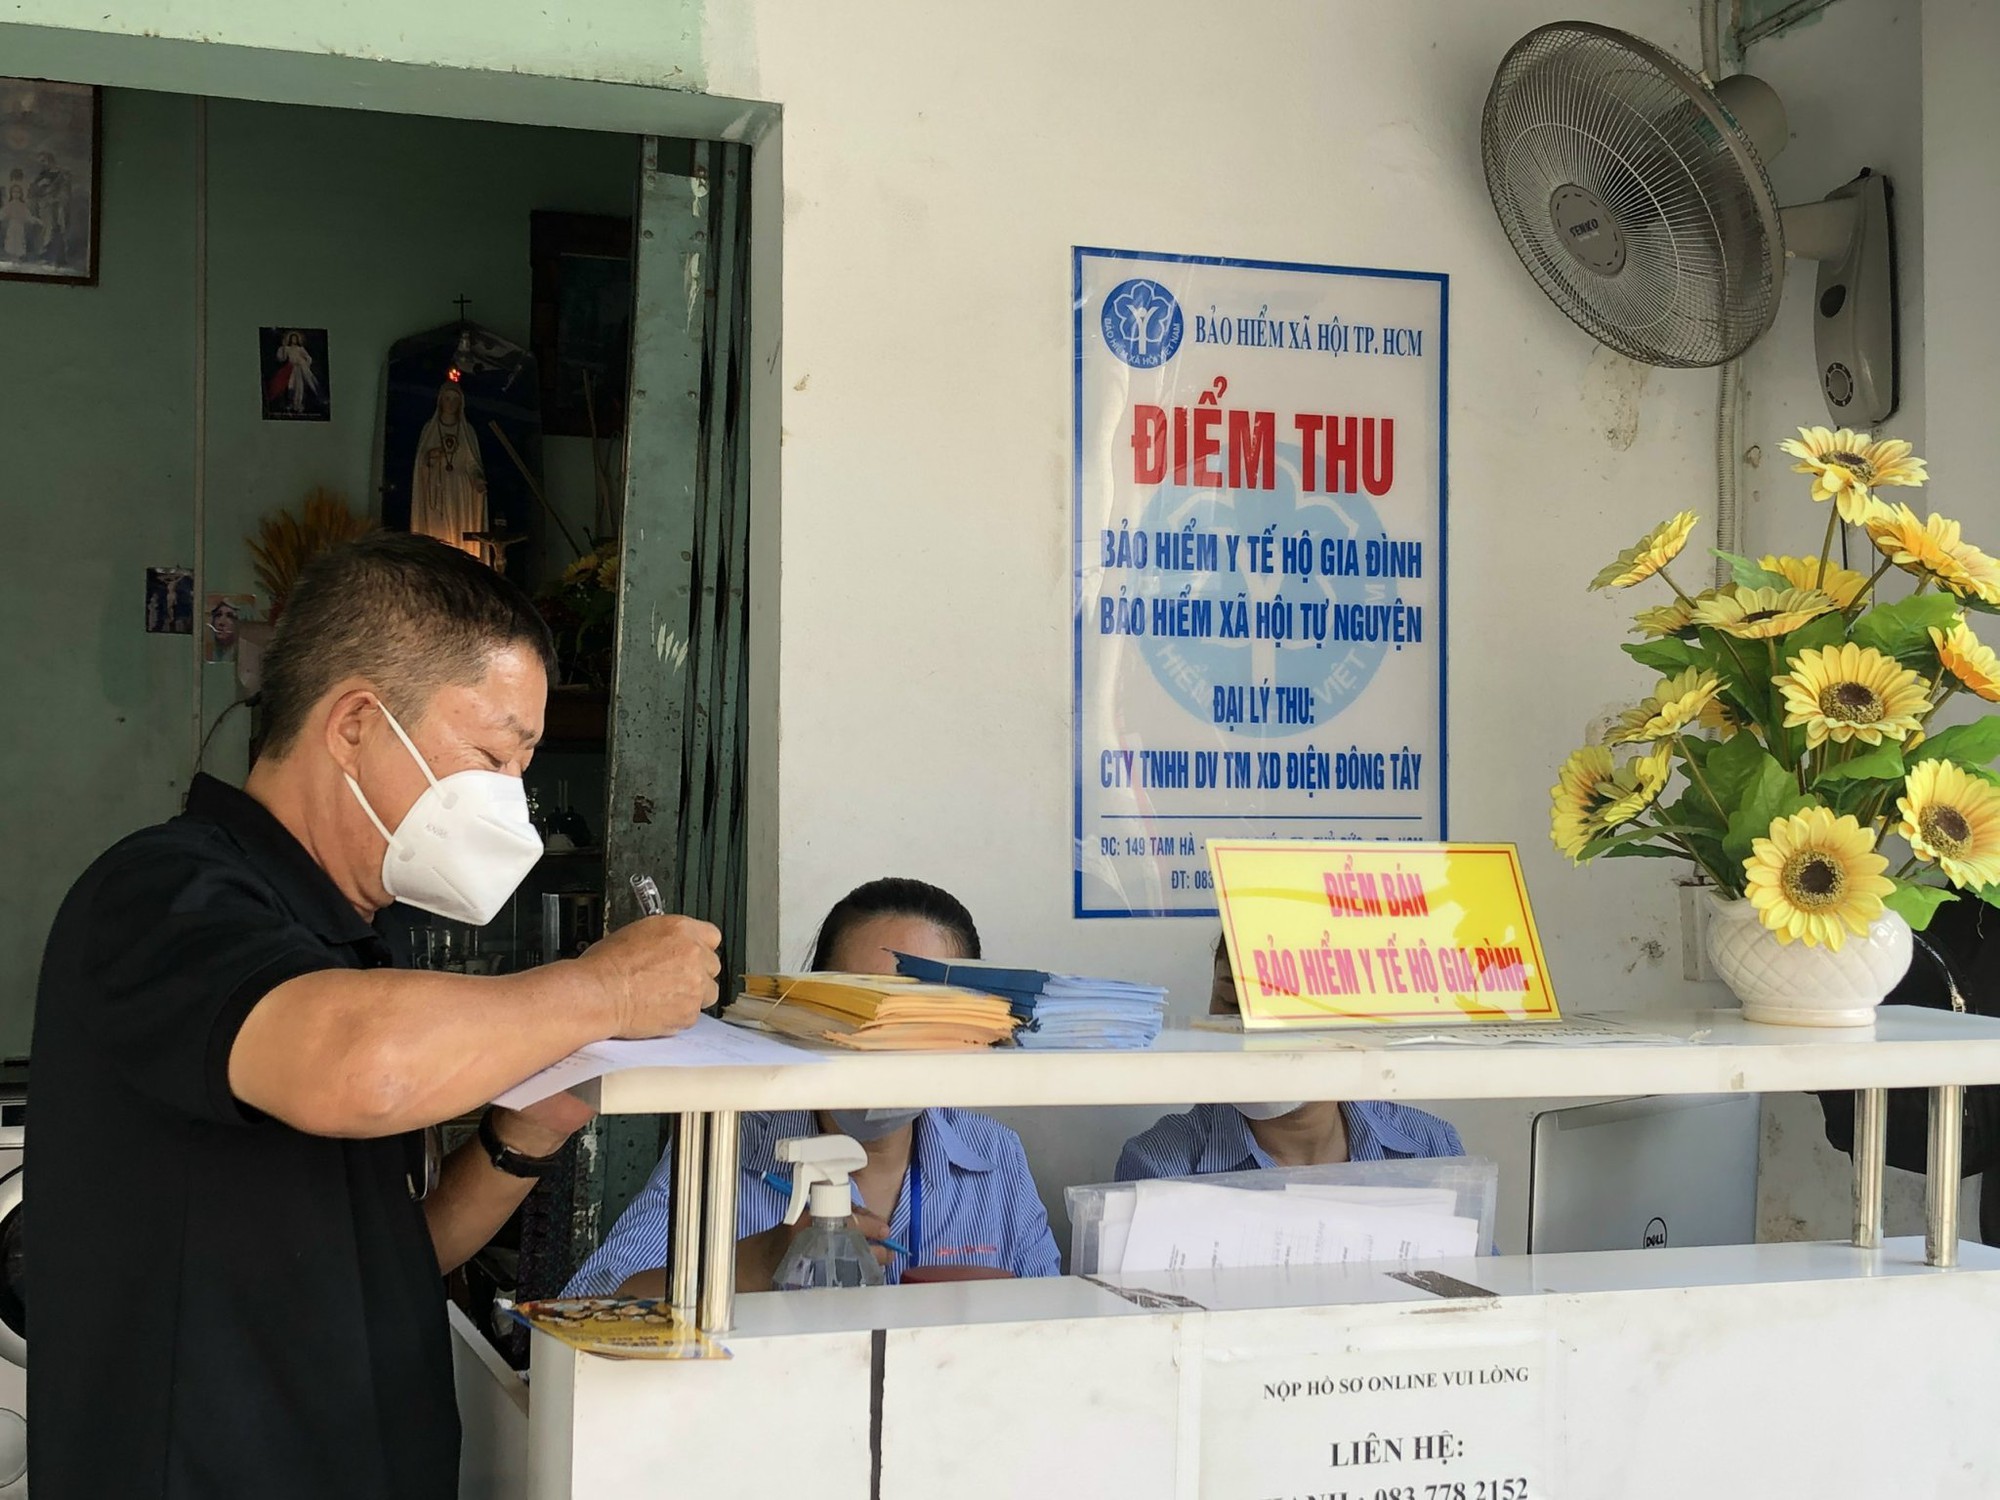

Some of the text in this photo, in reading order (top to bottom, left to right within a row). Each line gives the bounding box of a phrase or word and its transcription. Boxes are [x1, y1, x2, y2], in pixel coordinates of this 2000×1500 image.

[1569, 218, 1598, 238] SENKO
[1195, 304, 1232, 345] BẢO
[1236, 304, 1284, 349] HIỂM
[1288, 314, 1311, 351] XÃ
[1317, 315, 1348, 358] HỘI
[1382, 328, 1423, 357] HCM
[1131, 376, 1394, 497] ĐIỂM THU
[1101, 518, 1422, 584] BẢO HIỂM Y TẾ HỘ GIA ĐÌNH
[1100, 585, 1145, 636] BẢO
[1152, 584, 1212, 638] HIỂM
[1219, 592, 1249, 639] XÃ
[1256, 595, 1293, 648] HỘI
[1300, 599, 1329, 649] TỰ
[1334, 598, 1422, 651] NGUYỆN
[1213, 678, 1315, 732] ĐẠI LÝ THU:
[1101, 745, 1423, 798] CTY TNHH DV TM XD ĐIỆN ĐÔNG TÂY
[1125, 836, 1146, 857] 149
[1150, 836, 1175, 857] TAM
[1179, 831, 1196, 856] HÀ
[1171, 870, 1190, 889] ĐT:
[1322, 854, 1429, 918] ĐIỂM BÁN
[1252, 930, 1530, 1004] BẢO HIỂM Y TẾ HỘ GIA ĐÌNH
[1646, 1233, 1664, 1247] DELL
[1264, 1380, 1302, 1402] NỘP
[1338, 1376, 1364, 1394] SƠ
[1368, 1372, 1437, 1392] ONLINE
[1443, 1370, 1473, 1386] VUI
[1479, 1365, 1529, 1385] LÒNG
[1329, 1430, 1463, 1467] LIÊN HỆ:
[1424, 1482, 1467, 1500] 778
[1473, 1477, 1528, 1500] 2152
